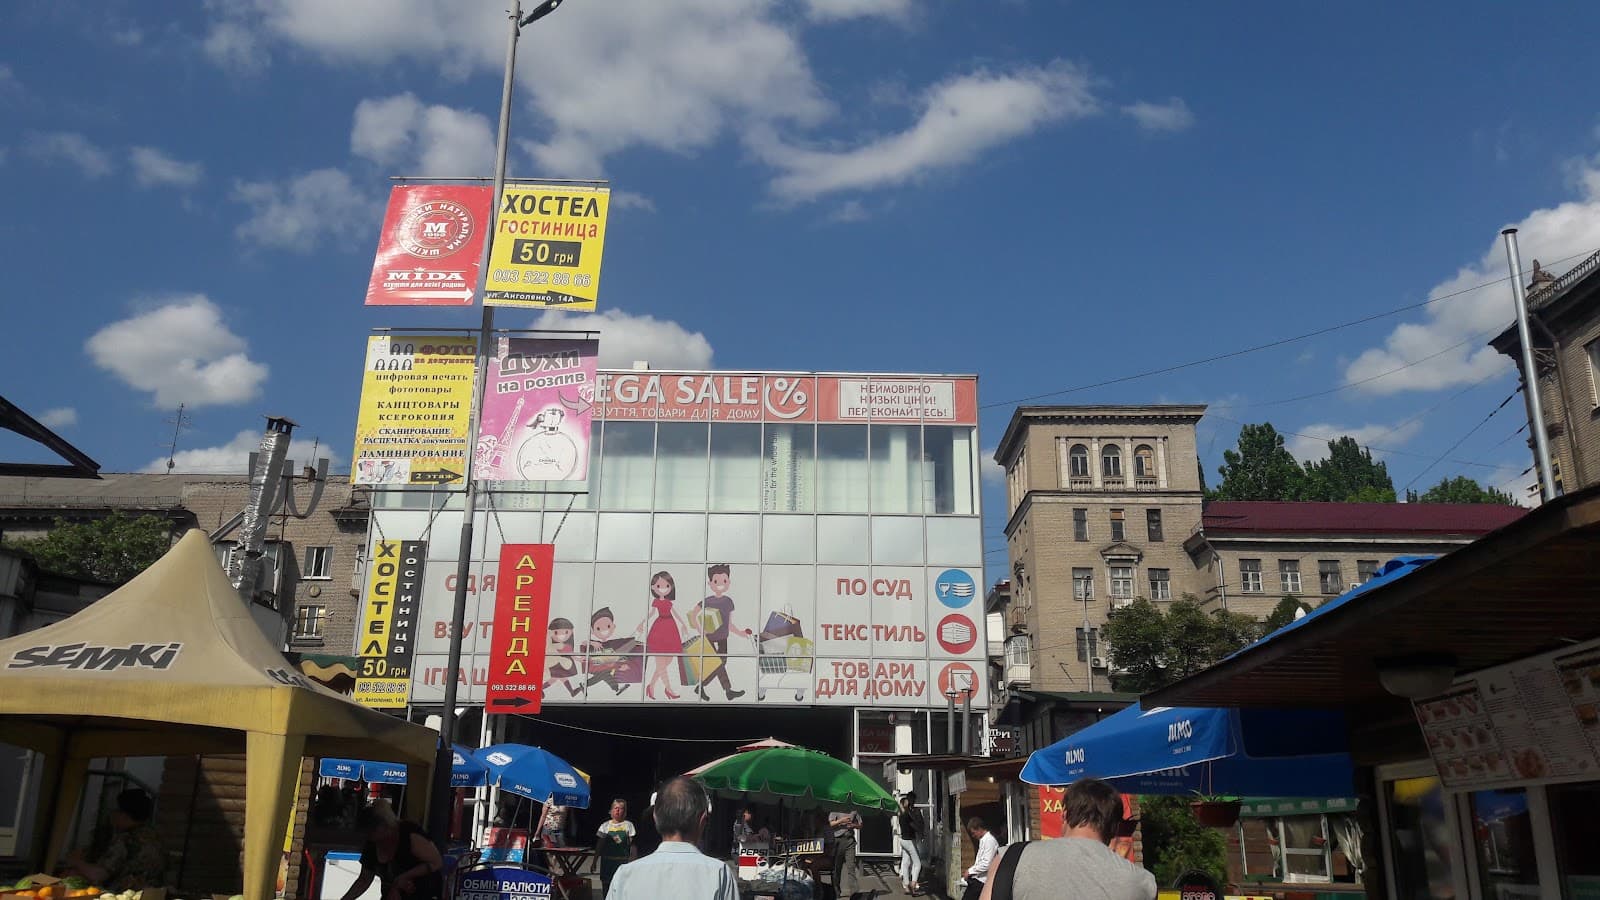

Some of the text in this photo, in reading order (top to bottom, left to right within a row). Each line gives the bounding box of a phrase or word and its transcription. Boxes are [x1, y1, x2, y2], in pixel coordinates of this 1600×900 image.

[503, 194, 599, 217] ХОСТЕЛ
[520, 242, 574, 265] 50 грн
[493, 269, 591, 287] 093 522 88 66
[419, 344, 477, 355] ФОТО
[376, 373, 428, 382] цифровая
[498, 372, 585, 393] на розлив
[389, 385, 452, 395] фототовары
[594, 375, 666, 403] EGA
[676, 376, 759, 404] SALE
[861, 383, 931, 394] НЕЙМОВІРНО
[377, 401, 460, 410] КАНЦТОВАРЫ
[860, 395, 937, 407] НИЗЬКІ ЦІНИ!
[640, 407, 687, 417] ТОВАРИ
[691, 409, 719, 420] ДЛЯ
[726, 409, 760, 420] ДОМУ
[848, 407, 947, 417] ПЕРЕКОНАЙТЕСЬ!
[360, 450, 464, 458] ЛАМИНИРОВАНИЕ
[836, 578, 913, 600] ПОСУД
[364, 543, 396, 655] ХОСТЕЛ
[505, 554, 537, 675] АРЕНДА
[821, 624, 926, 642] ТЕКСТИЛЬ
[363, 659, 407, 676] 50 грн
[831, 661, 915, 680] ТОВАРИ
[358, 681, 372, 692] 093
[372, 682, 386, 693] 522
[397, 682, 407, 693] 66
[816, 678, 926, 699] ДЛЯ ДОМУ
[1043, 799, 1063, 813] ХА
[740, 848, 768, 856] PEPSI
[463, 879, 551, 893] ОБМІН ВАЛЮТИ
